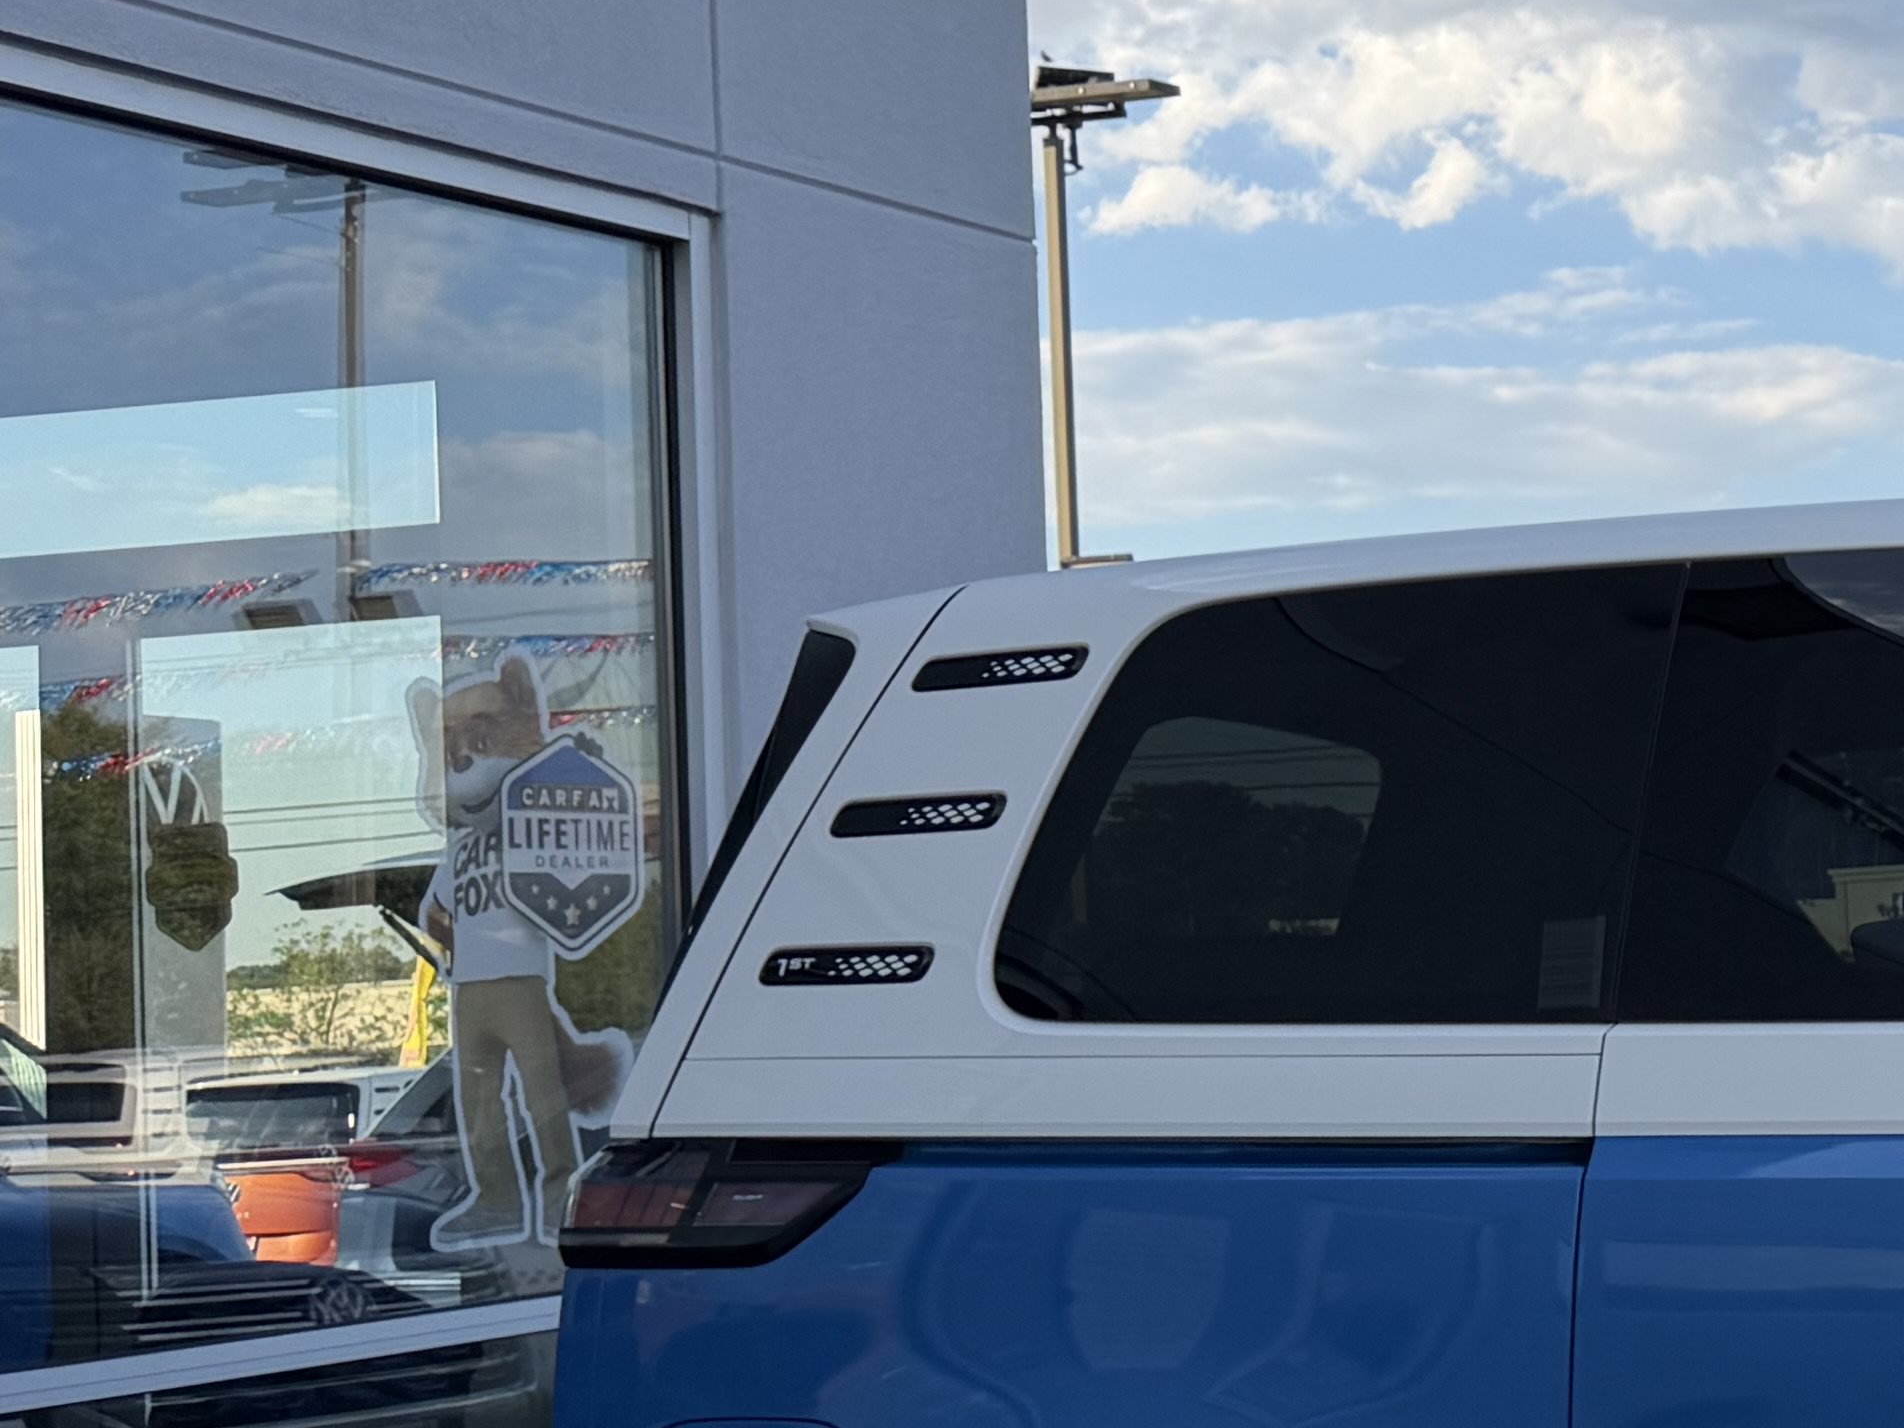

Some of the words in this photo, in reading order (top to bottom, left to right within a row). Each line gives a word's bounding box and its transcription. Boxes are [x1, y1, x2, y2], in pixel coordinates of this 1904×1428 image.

[521, 786, 619, 812] CARFAX
[507, 817, 632, 852] LIFETIME
[535, 855, 610, 869] DEALER
[454, 871, 506, 924] FOX
